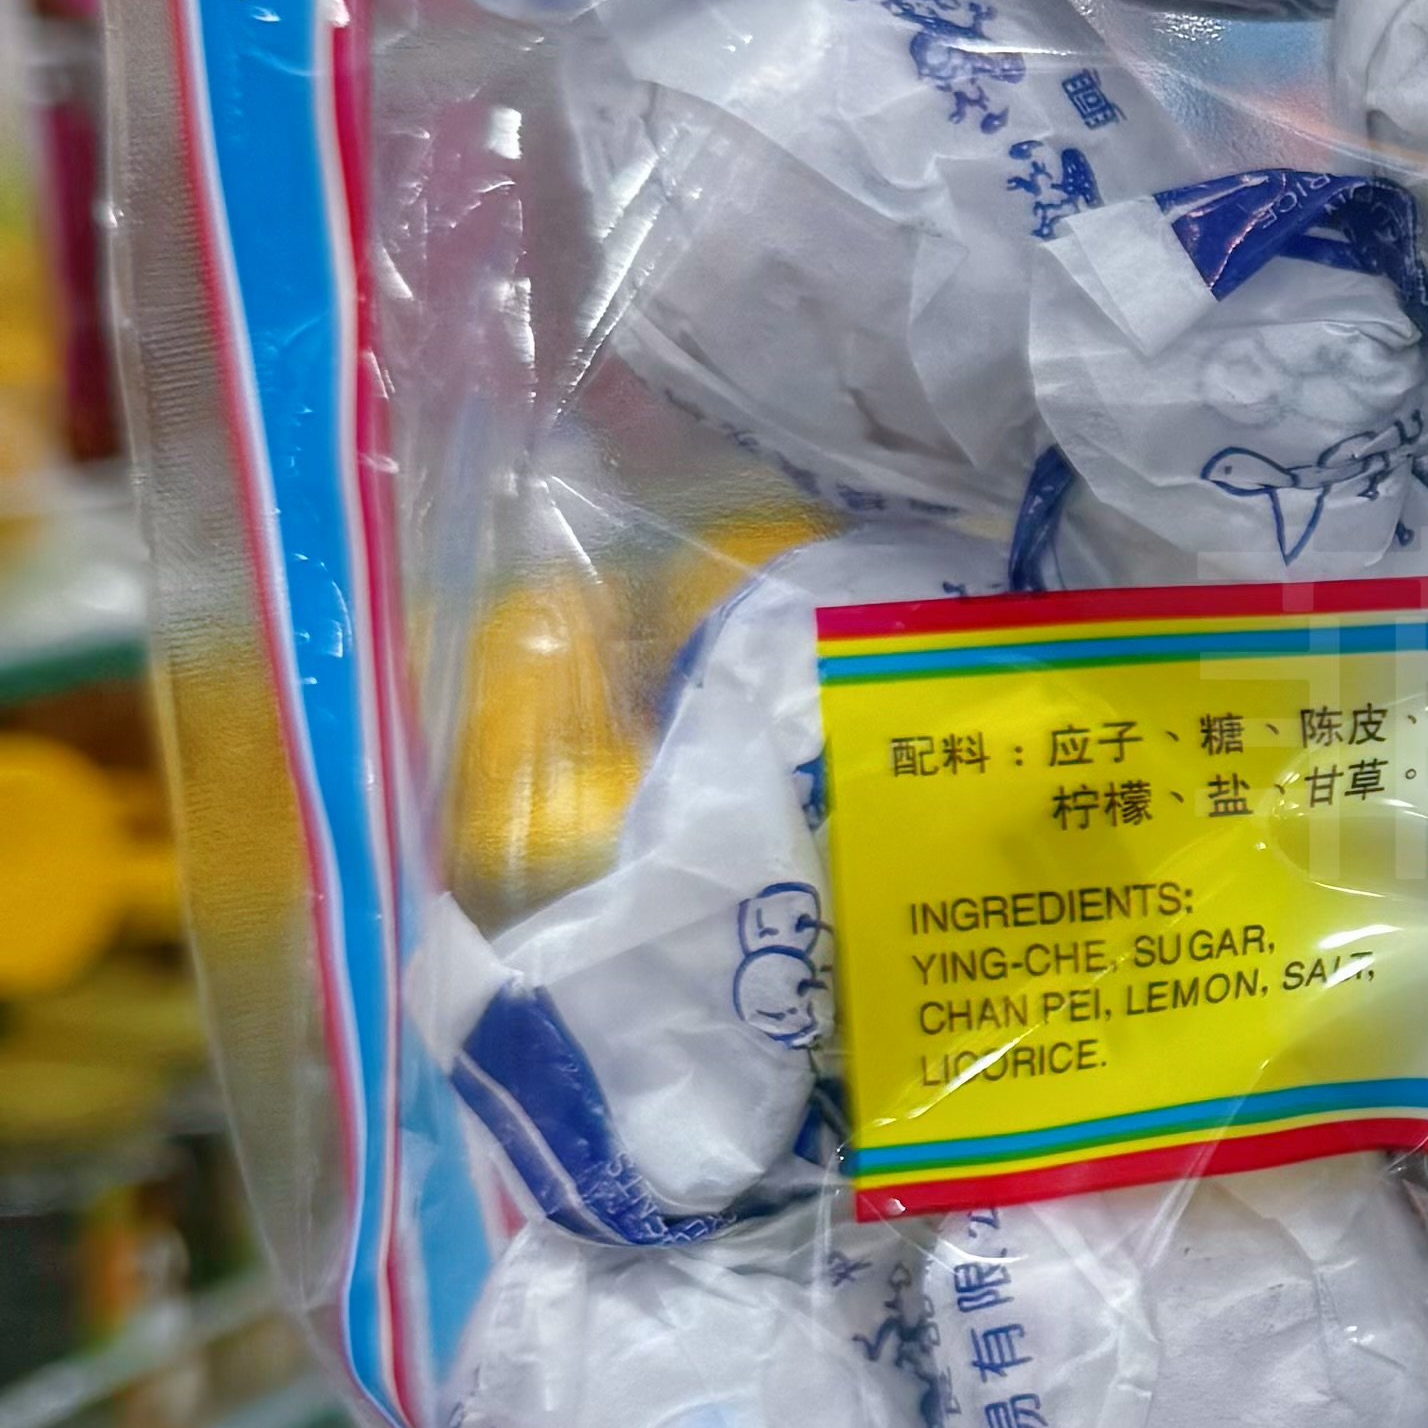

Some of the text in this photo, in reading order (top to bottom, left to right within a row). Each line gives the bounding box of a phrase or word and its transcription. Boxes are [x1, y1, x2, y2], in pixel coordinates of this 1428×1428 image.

[909, 882, 1194, 935] INGREDIENTS:
[911, 925, 1276, 987] YING-CHE, SUGAR,
[919, 994, 1028, 1036] CHAN
[1043, 989, 1112, 1026] PEI,
[1125, 968, 1269, 1016] LEMON,
[920, 1039, 1107, 1087] LICORICE.
